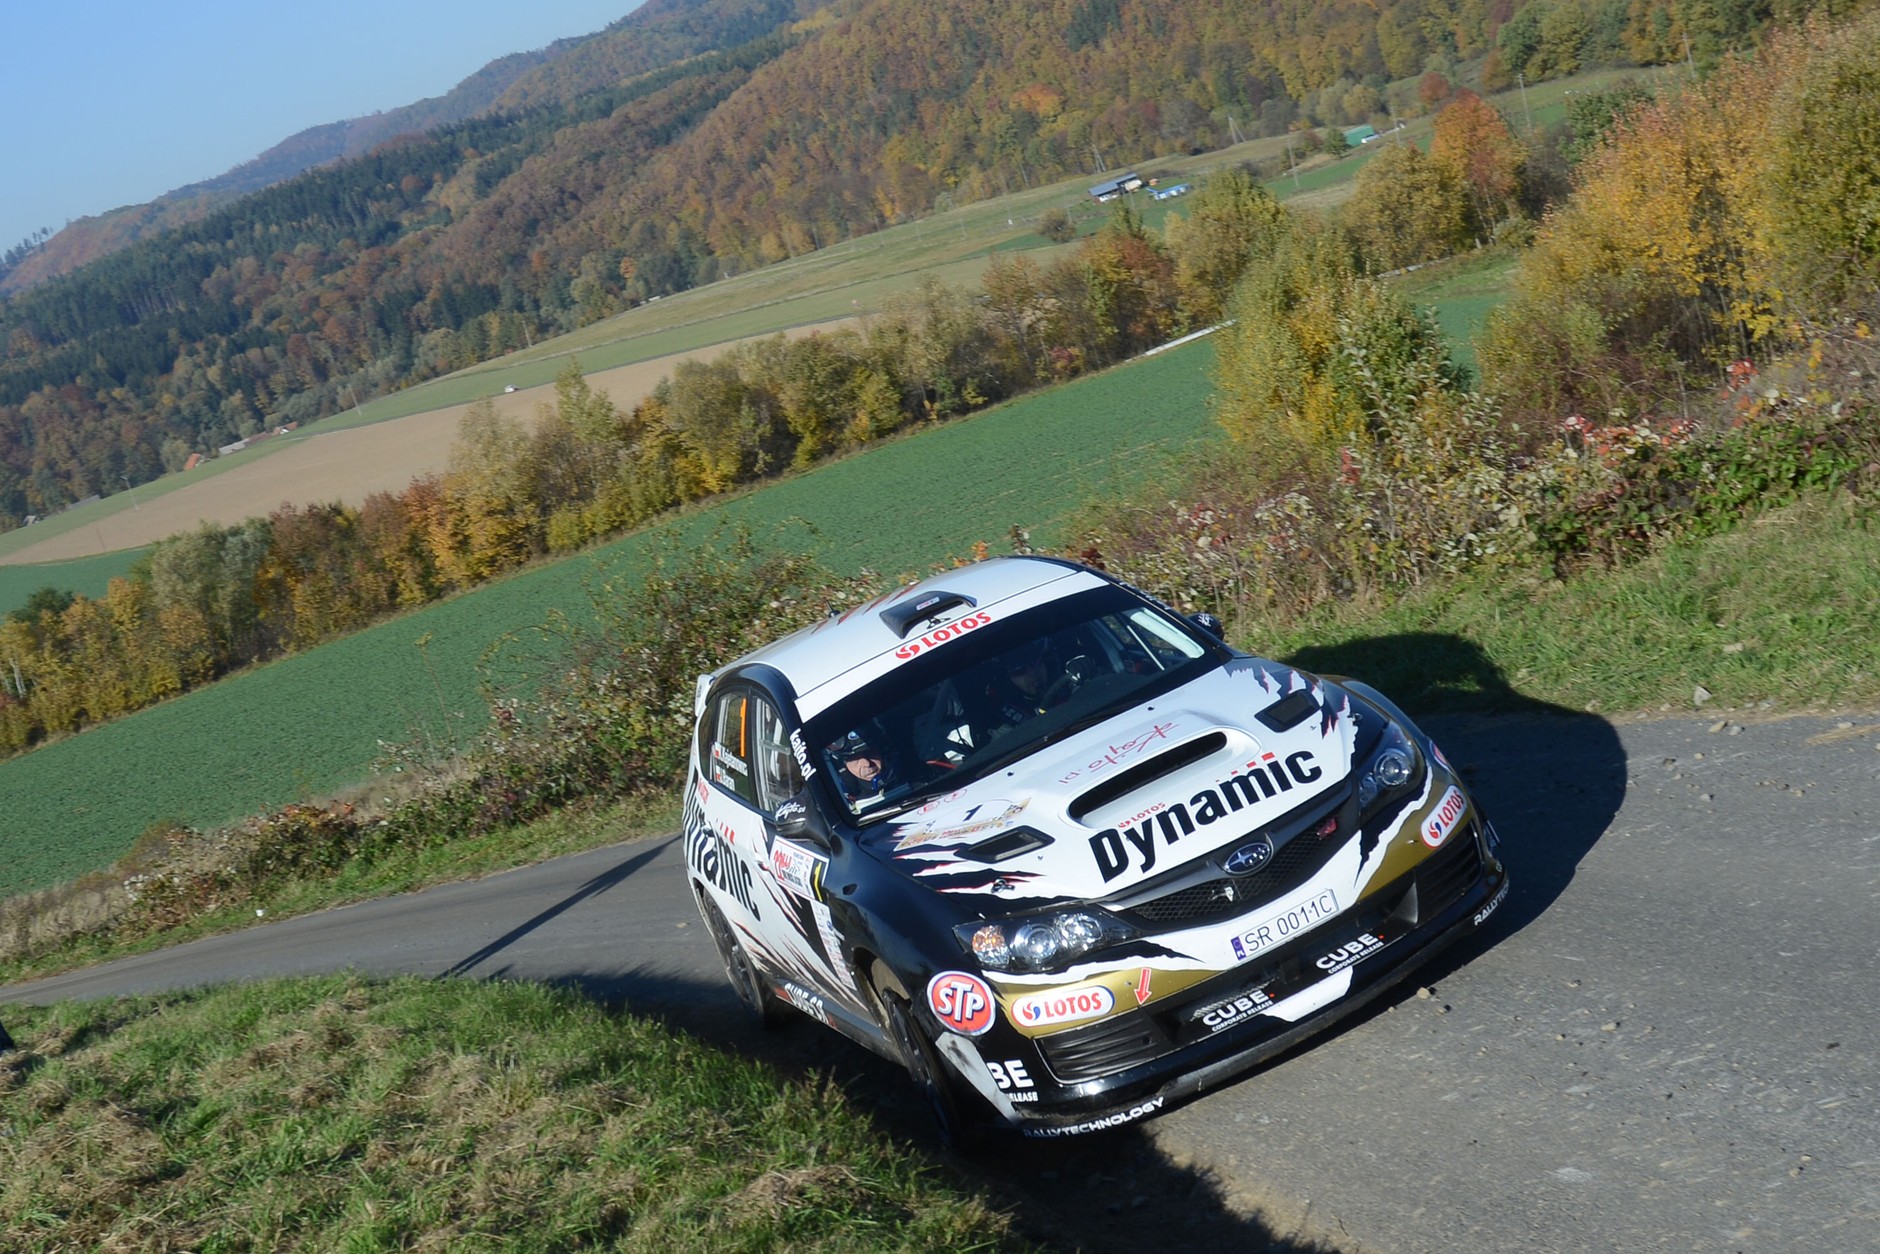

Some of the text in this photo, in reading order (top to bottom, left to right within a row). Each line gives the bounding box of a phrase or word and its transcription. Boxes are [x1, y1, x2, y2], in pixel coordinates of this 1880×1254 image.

[921, 611, 992, 648] LOTOS
[963, 804, 983, 821] 1
[1088, 751, 1322, 883] Dynamic
[1131, 802, 1166, 821] LOTOS
[1438, 790, 1465, 828] LOTOS
[1245, 895, 1332, 951] SR 0011C
[937, 981, 985, 1022] STP
[1044, 991, 1102, 1018] LOTOS
[1211, 1000, 1273, 1032] CORPORATE RELEASE
